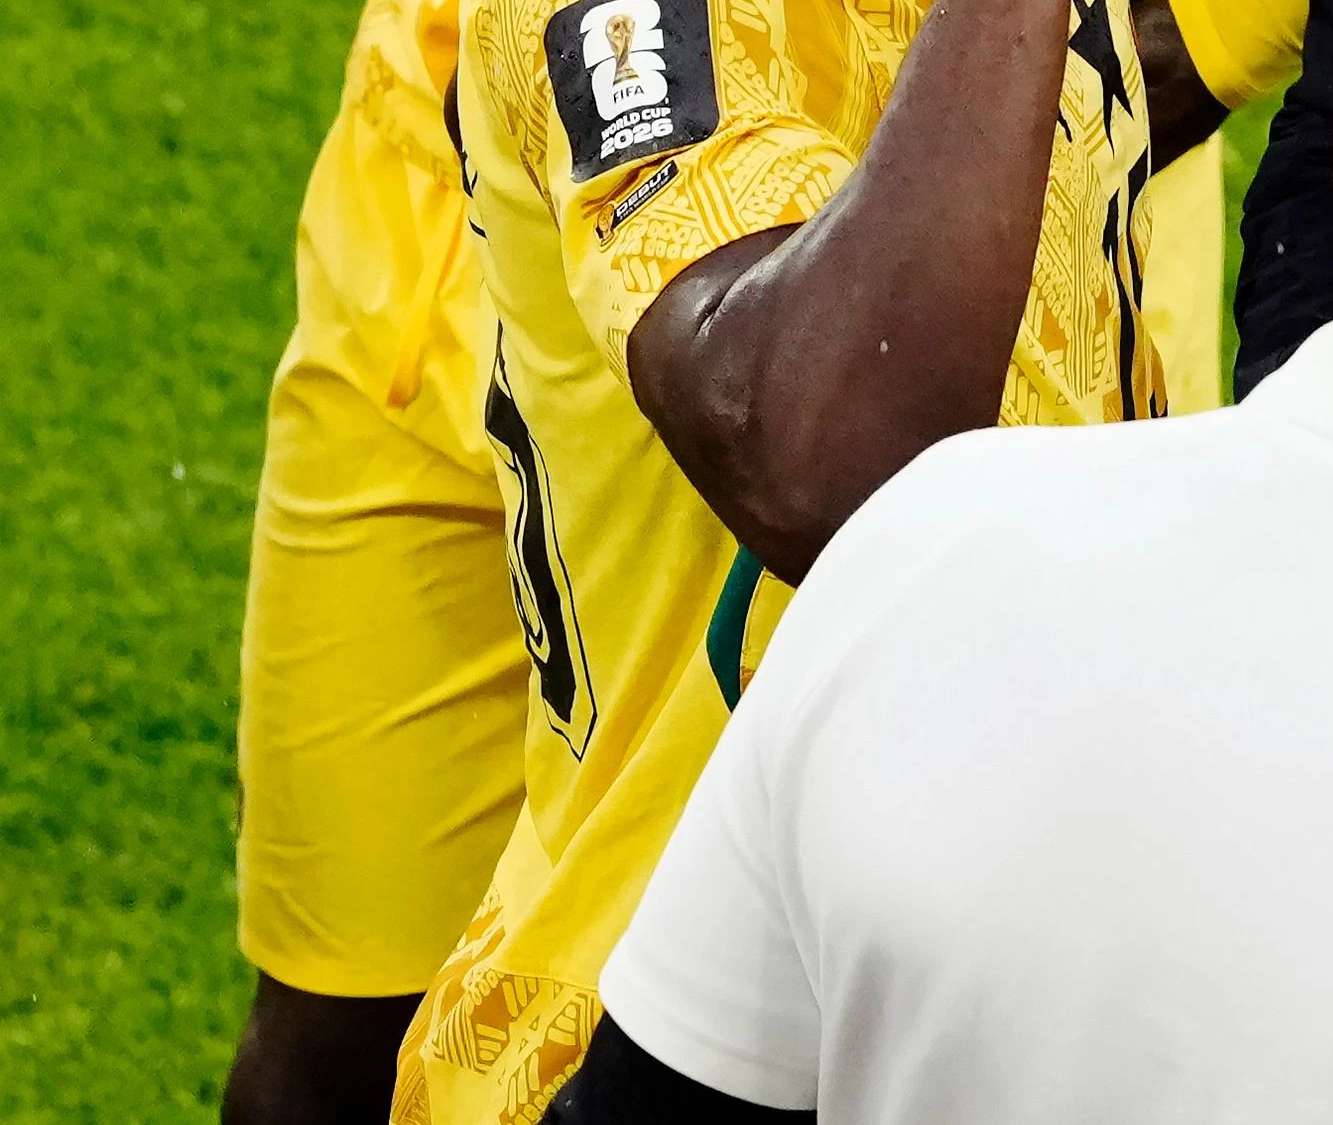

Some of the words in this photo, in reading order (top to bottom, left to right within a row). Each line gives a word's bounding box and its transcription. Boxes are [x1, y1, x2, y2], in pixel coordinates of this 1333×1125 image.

[613, 85, 645, 104] FIFA
[600, 118, 674, 160] 2026
[601, 112, 641, 141] WORLD
[641, 107, 671, 121] CUP
[616, 163, 673, 218] DEBUT
